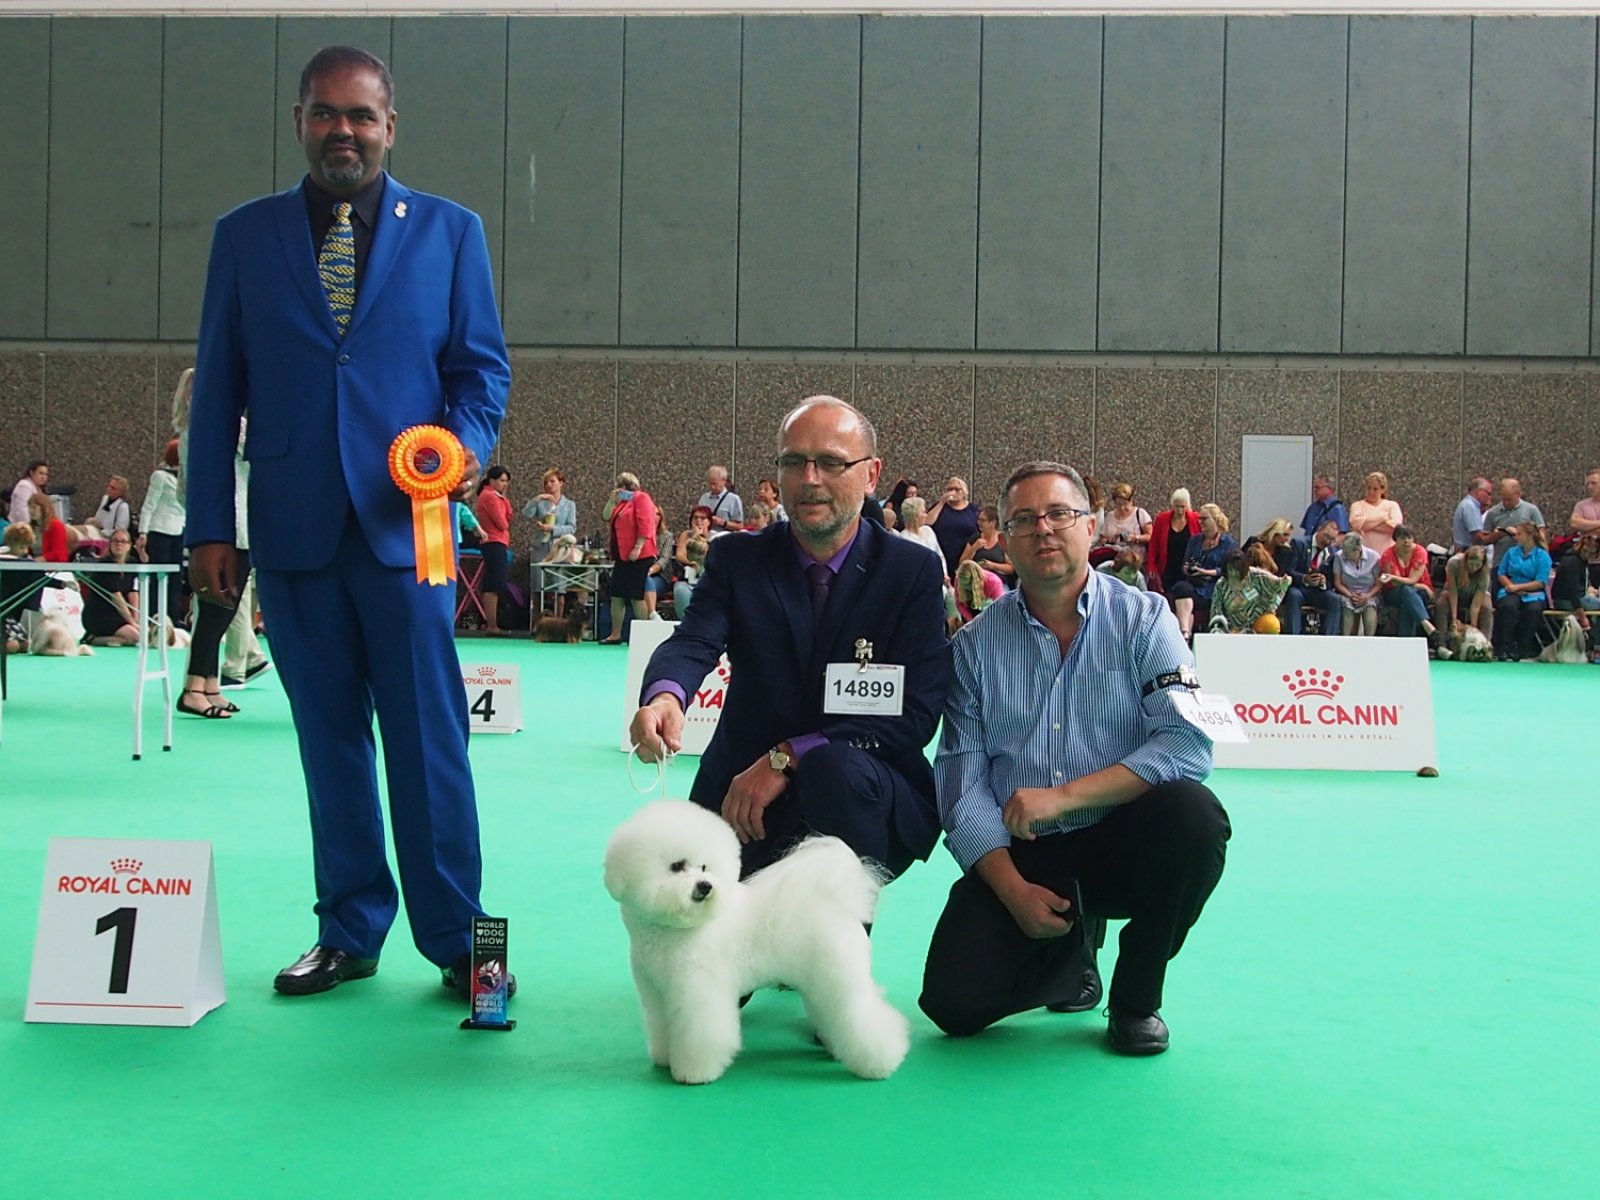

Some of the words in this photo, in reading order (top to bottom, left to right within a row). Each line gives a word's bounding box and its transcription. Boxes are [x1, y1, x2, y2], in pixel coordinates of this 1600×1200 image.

[464, 677, 484, 685] OYAL
[833, 679, 895, 698] 14899
[470, 689, 496, 722] 4
[1189, 710, 1233, 726] 14894
[1234, 703, 1312, 725] ROYAL
[1317, 704, 1398, 726] CANIN
[58, 876, 120, 894] ROYAL
[126, 877, 192, 896] CANIN
[476, 921, 505, 929] WORLD
[483, 929, 505, 937] DOG
[476, 937, 504, 945] SHOW
[95, 907, 138, 994] 1
